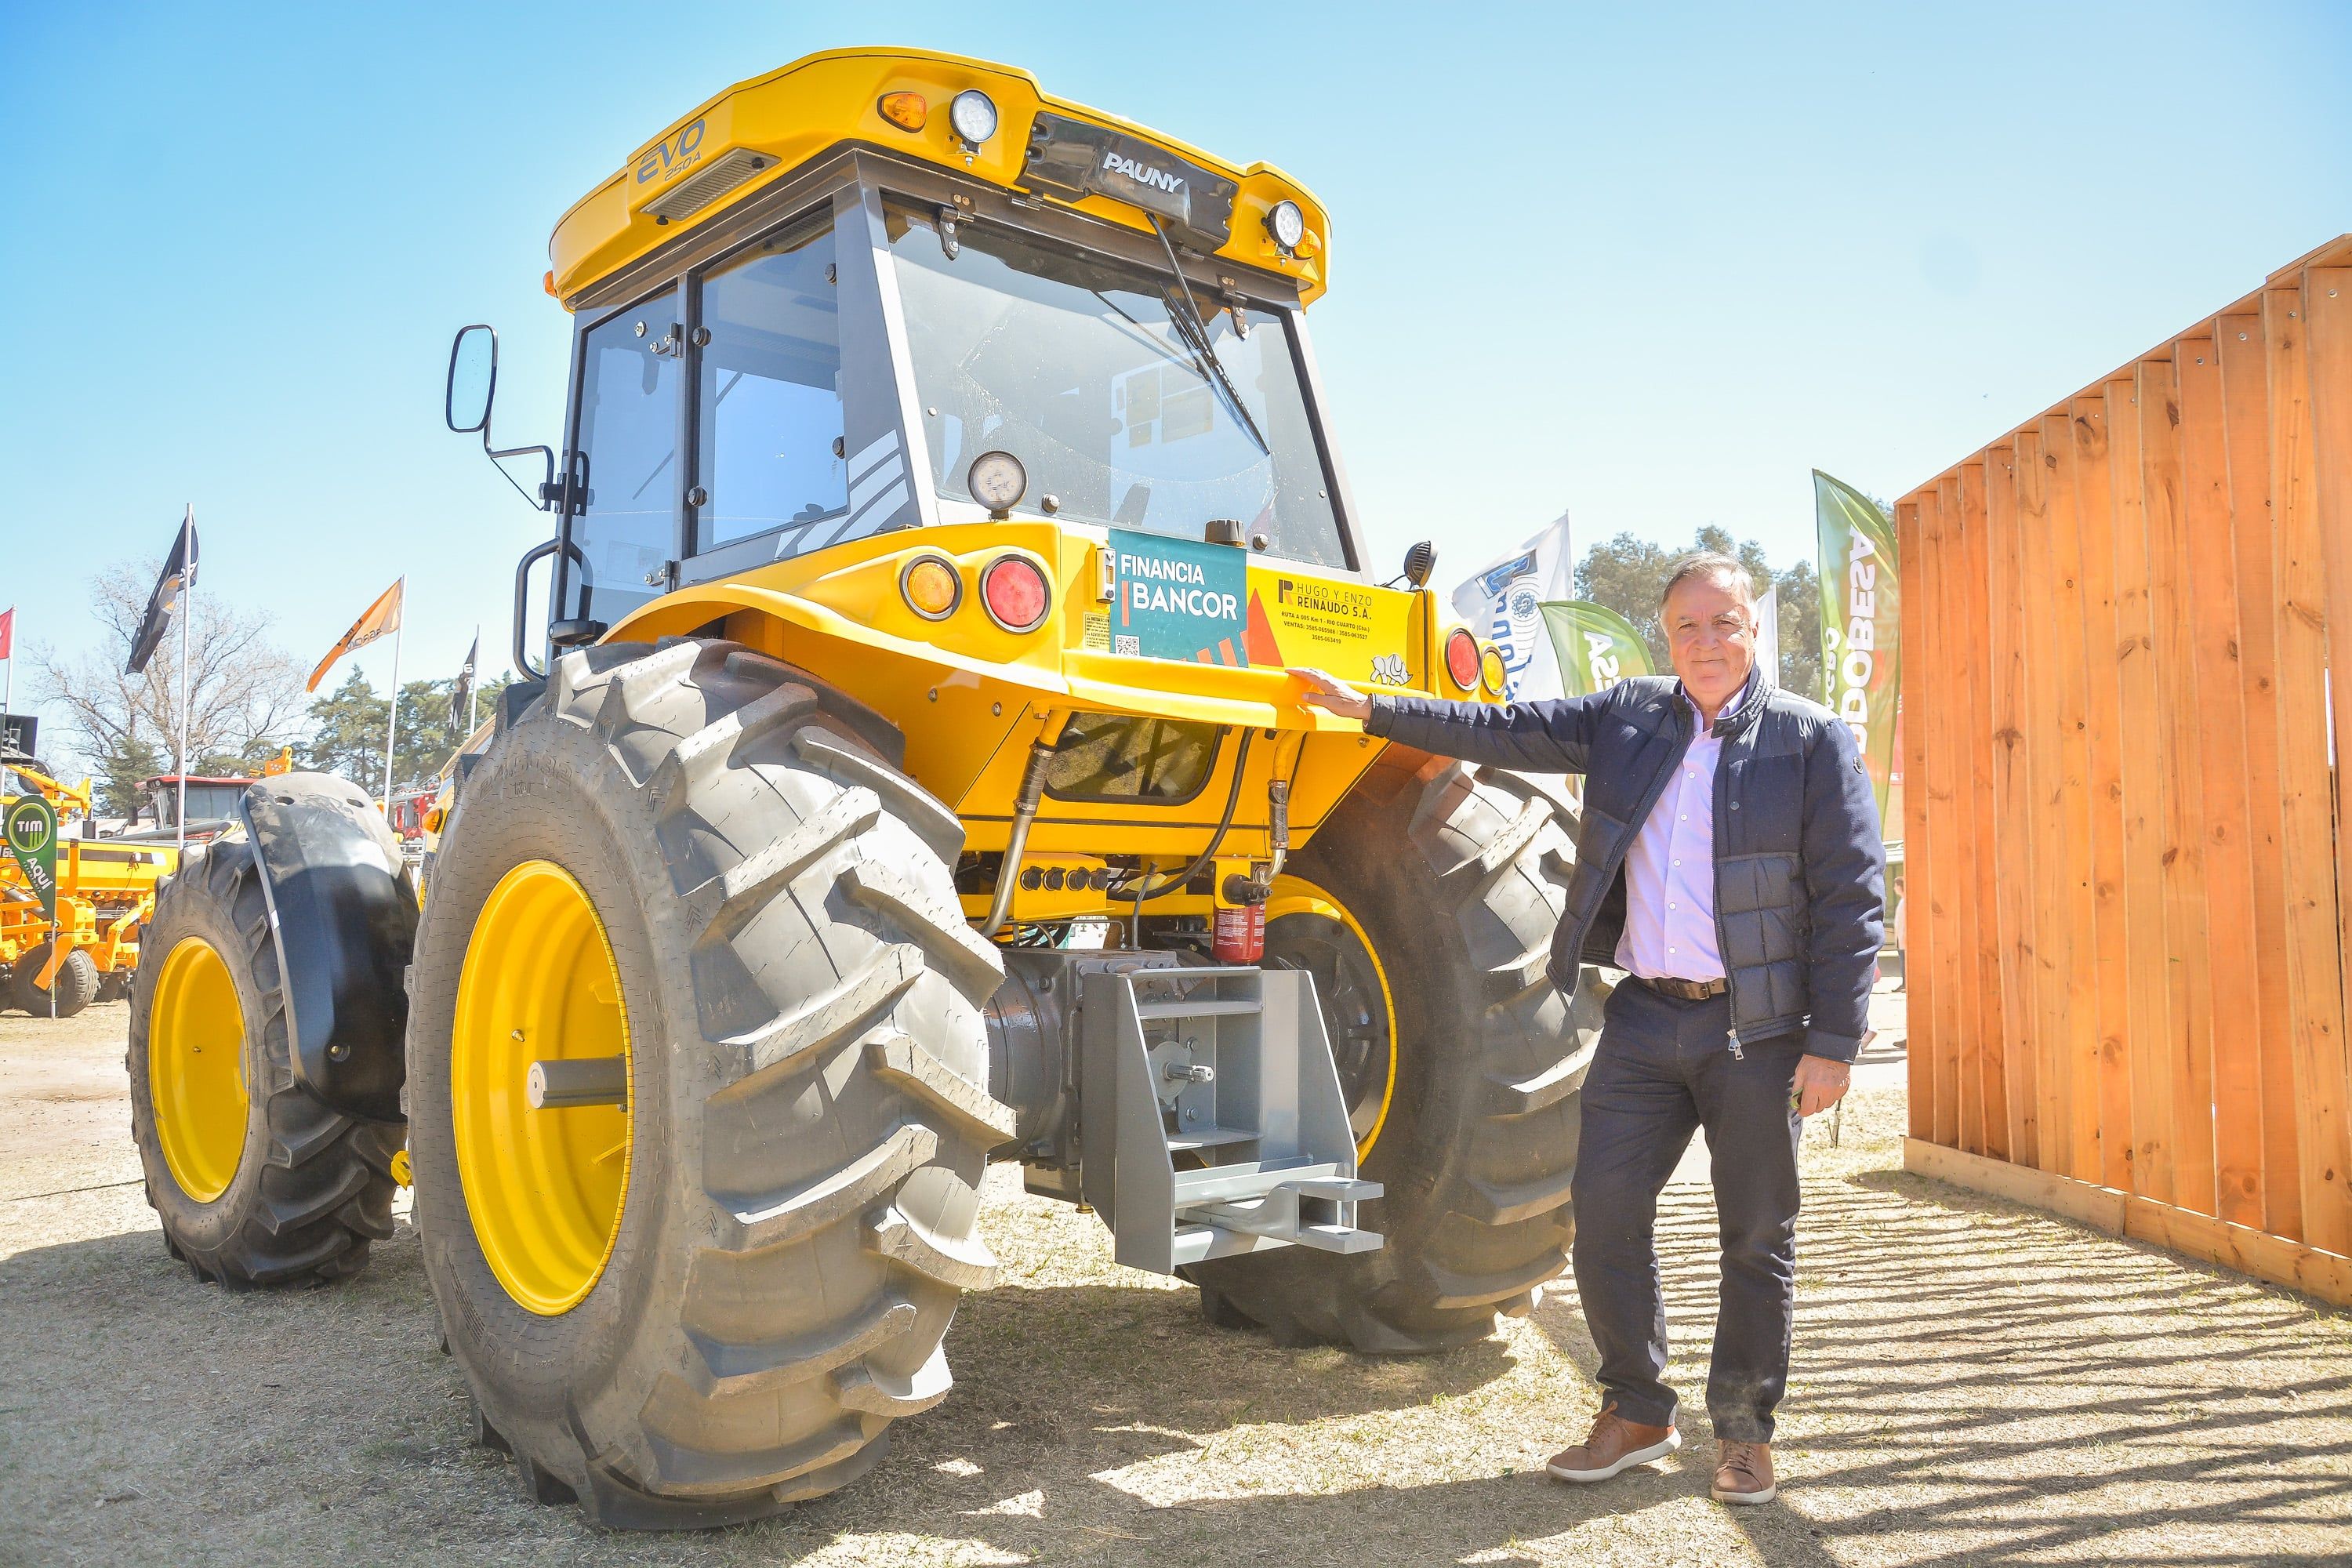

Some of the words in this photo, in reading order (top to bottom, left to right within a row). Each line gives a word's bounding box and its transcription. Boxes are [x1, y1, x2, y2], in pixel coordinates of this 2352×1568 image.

[637, 118, 706, 184] EVO
[1102, 151, 1184, 194] PAUNY
[1120, 554, 1205, 586] FINANCIA
[1132, 582, 1238, 621] BANCOR
[1297, 583, 1328, 598] HUGO
[1334, 590, 1339, 600] Y
[1345, 592, 1372, 607] ENZO
[1298, 596, 1348, 615] REINAUDO
[1352, 606, 1372, 620] S.A.
[1336, 621, 1356, 630] CUARTO
